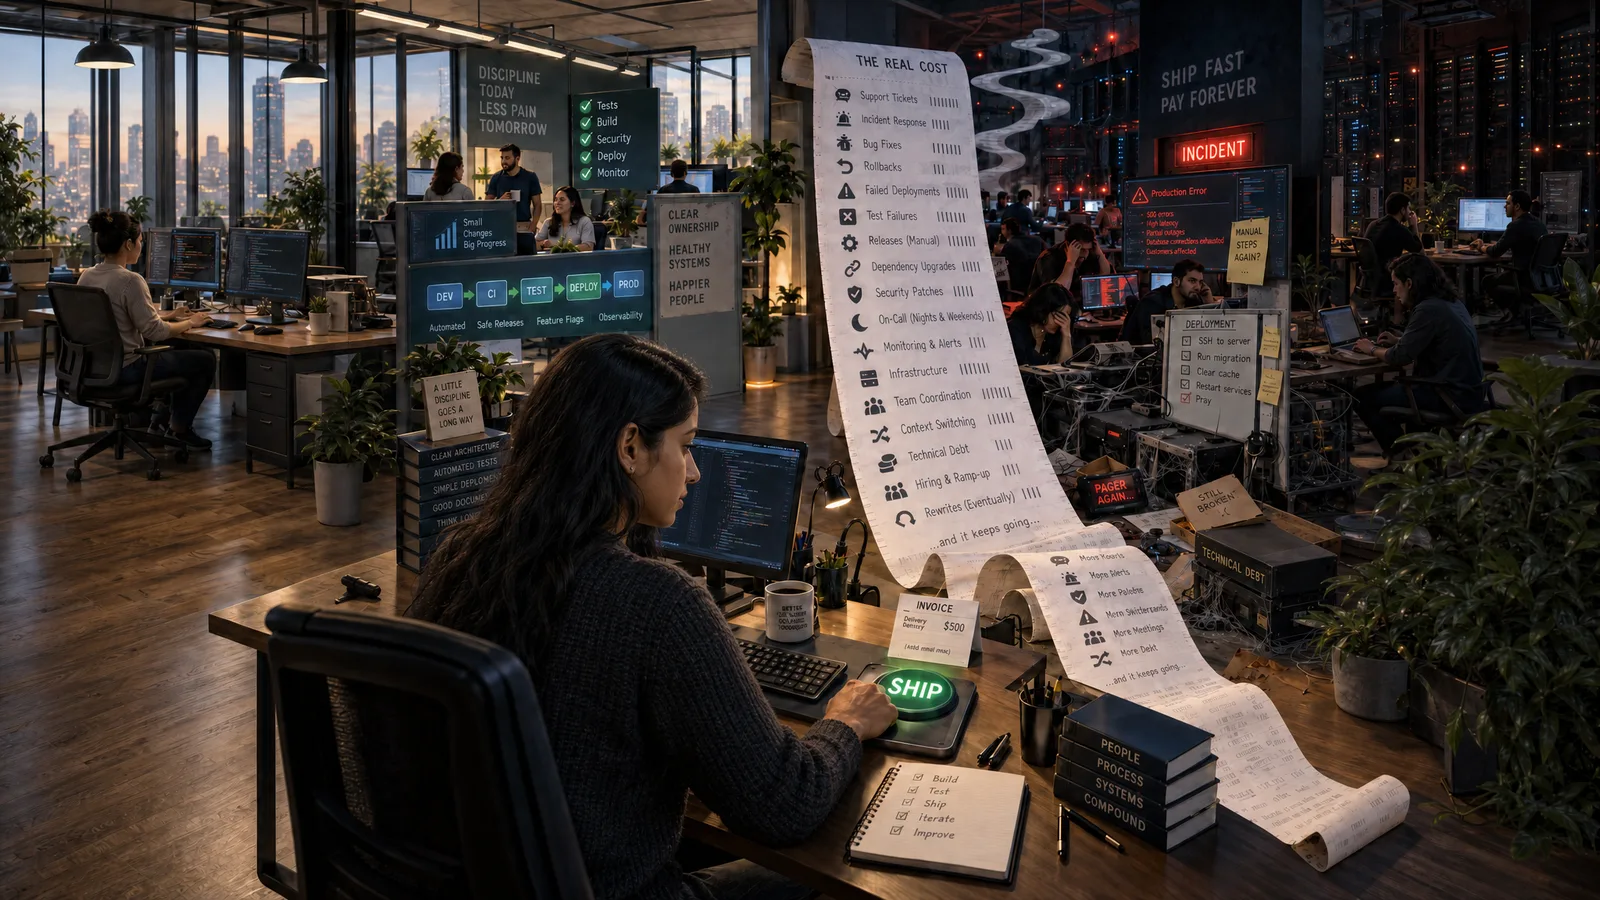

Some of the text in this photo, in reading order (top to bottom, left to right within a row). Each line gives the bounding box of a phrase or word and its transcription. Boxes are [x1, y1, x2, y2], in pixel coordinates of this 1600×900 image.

[856, 55, 947, 73] THE REAL COST
[1161, 50, 1244, 89] SHIP FAST
[479, 66, 541, 85] DISCIPLINE
[480, 83, 514, 99] TODAY
[1161, 77, 1256, 113] PAY FOREVER
[861, 91, 918, 104] Support Tickets
[479, 102, 536, 118] LESS PAIN
[597, 100, 618, 110] Tests
[480, 118, 547, 136] TOMORROW
[597, 117, 618, 127] Build
[862, 115, 926, 128] Incident Response
[597, 133, 631, 145] Security
[863, 139, 902, 151] Bug Fixes
[597, 151, 626, 162] Deploy
[1182, 140, 1245, 162] INCIDENT
[864, 161, 902, 171] Rollbacks
[598, 167, 629, 178] Monitor
[866, 185, 940, 198] Failed Deployments
[1152, 189, 1186, 197] Production
[669, 209, 699, 220] CLEAR
[867, 210, 917, 220] Test Failures
[463, 218, 482, 227] Small
[669, 221, 719, 233] OWNERSHIP
[463, 229, 492, 239] Changes
[1236, 227, 1262, 236] MANUAL
[463, 239, 506, 250] Big Progress
[869, 235, 940, 247] Releases (Manual)
[1237, 240, 1257, 249] STEPS
[669, 243, 711, 255] HEALTHY
[1234, 253, 1260, 261] AGAIN?
[669, 258, 710, 269] SYSTEMS
[872, 261, 956, 273] Dependency Upgrades
[570, 282, 598, 292] DEPLOY
[619, 279, 639, 289] PROD
[669, 279, 710, 291] HAPPIER
[437, 292, 453, 302] DEV
[487, 290, 496, 299] CI
[527, 286, 547, 296] TEST
[876, 286, 943, 299] Security Patches
[670, 293, 704, 306] PEOPLE
[537, 315, 584, 325] Feature Flags
[599, 311, 643, 321] Observability
[879, 311, 984, 325] On-Call (Nights & Weekends)
[430, 321, 466, 332] Automated
[477, 319, 524, 330] Safe Releases
[1186, 320, 1236, 329] DEPLOYMENT
[884, 338, 962, 352] Monitoring & Alerts
[1214, 354, 1251, 364] migration
[890, 366, 948, 379] Infrastructure
[1197, 368, 1240, 379] Clear cache
[441, 380, 462, 391] LITTLE
[1196, 382, 1252, 396] Restart services
[435, 391, 471, 404] DISCIPLINE
[894, 390, 971, 407] Team Coordination
[1196, 395, 1211, 406] Pray
[438, 407, 456, 416] GOES
[439, 415, 473, 428] LONG WAY
[901, 416, 976, 435] Context Switching
[431, 441, 500, 461] CLEAN ARCHITECTURE
[908, 443, 970, 462] Technical Debt
[434, 457, 498, 477] AUTOMATED TESTS
[915, 469, 991, 490] Hiring & Ramp-up
[433, 482, 458, 495] SIMPLE
[1095, 480, 1127, 493] PAGER
[1098, 492, 1134, 504] AGAIN...
[1198, 489, 1223, 502] STILL
[433, 502, 453, 512] GOOD
[925, 490, 1016, 518] Rewrites (Eventually)
[436, 516, 458, 527] THINK
[930, 518, 1040, 550] ...and it keeps going...
[1202, 546, 1265, 584] TECHNICAL DEBT
[916, 601, 953, 613] INVOICE
[904, 616, 965, 632] Delivery $500
[1138, 668, 1158, 679] keeps
[888, 677, 943, 700] SHIP
[1101, 739, 1140, 765] PEOPLE
[1097, 758, 1144, 787] PROCESS
[932, 774, 959, 784] Build
[929, 787, 950, 796] Test
[1096, 778, 1144, 809] SYSTEMS
[924, 799, 946, 810] Ship
[1084, 793, 1146, 831] COMPOUND
[913, 828, 955, 840] Improve
